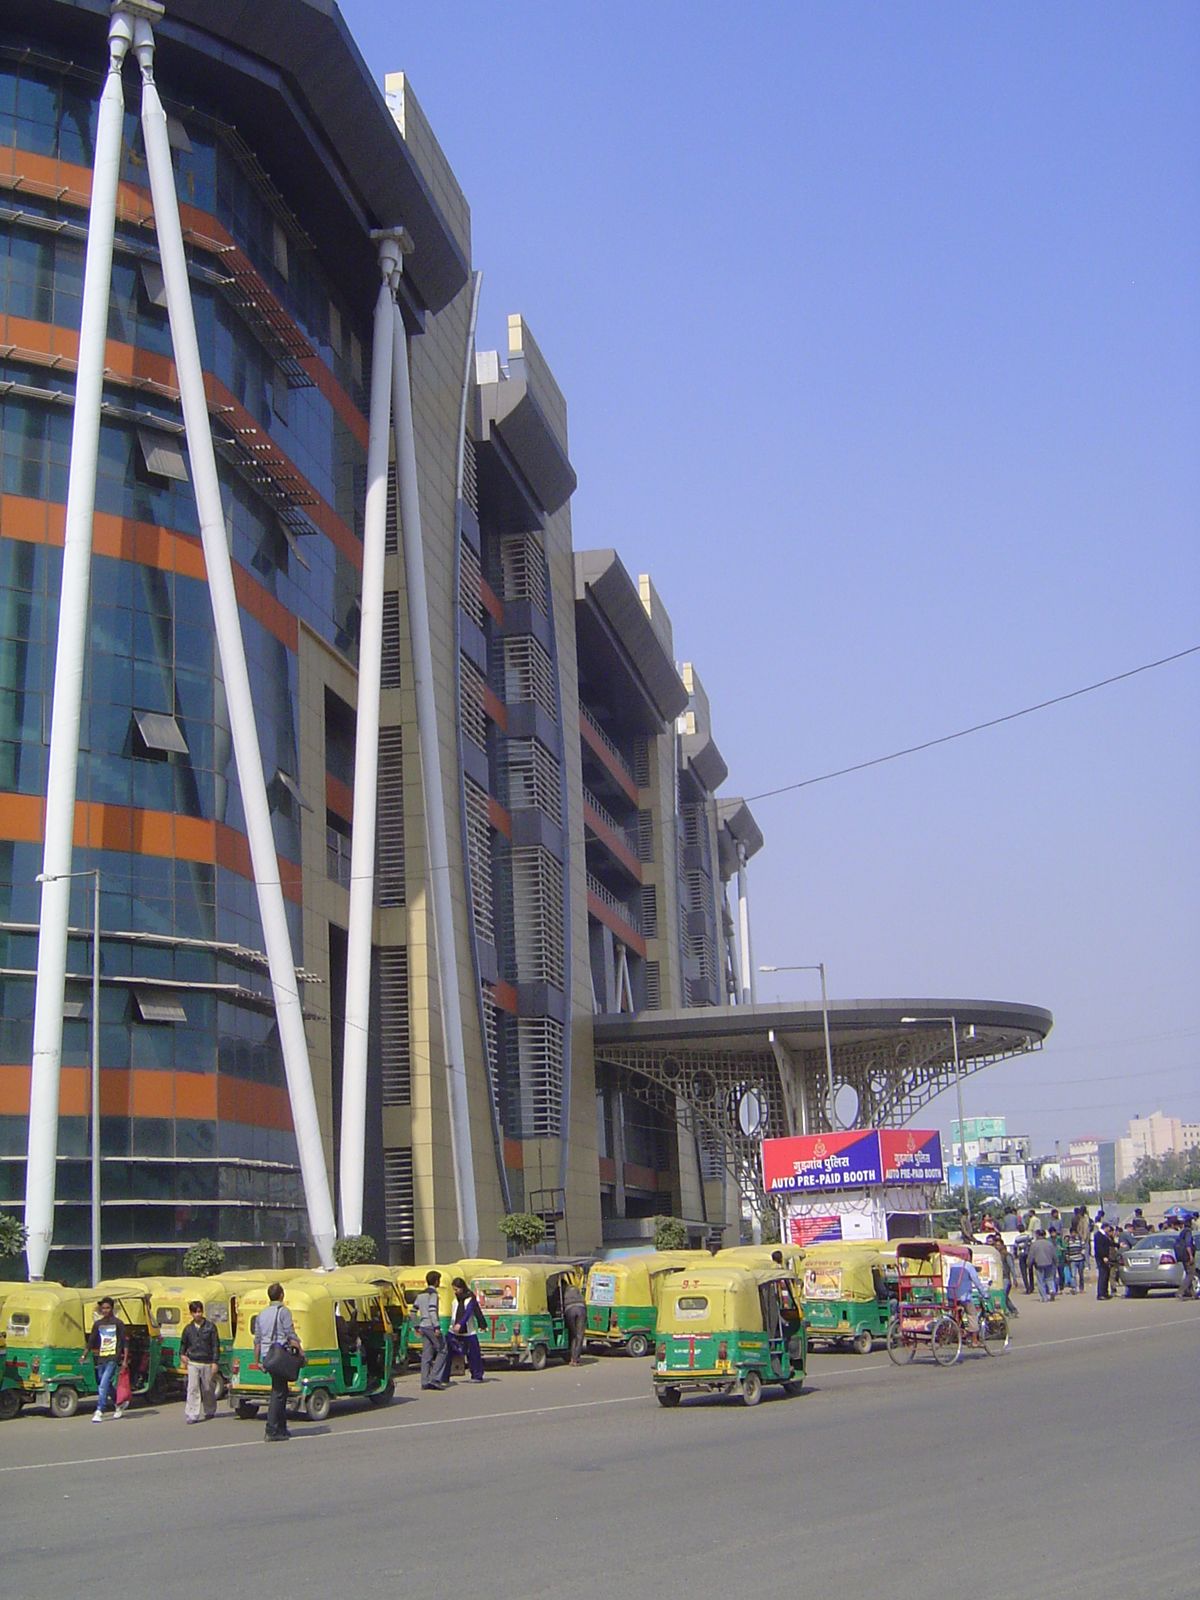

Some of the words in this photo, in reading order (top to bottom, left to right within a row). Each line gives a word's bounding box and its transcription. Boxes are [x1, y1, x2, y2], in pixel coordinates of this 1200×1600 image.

[823, 1155, 850, 1172] पुलिस
[771, 1176, 796, 1189] AUTO
[797, 1173, 841, 1187] PRE-PAID
[843, 1169, 876, 1183] BOOTH
[885, 1168, 900, 1179] AUTO
[900, 1168, 924, 1179] PRE-PAID
[924, 1168, 942, 1179] BOOTH
